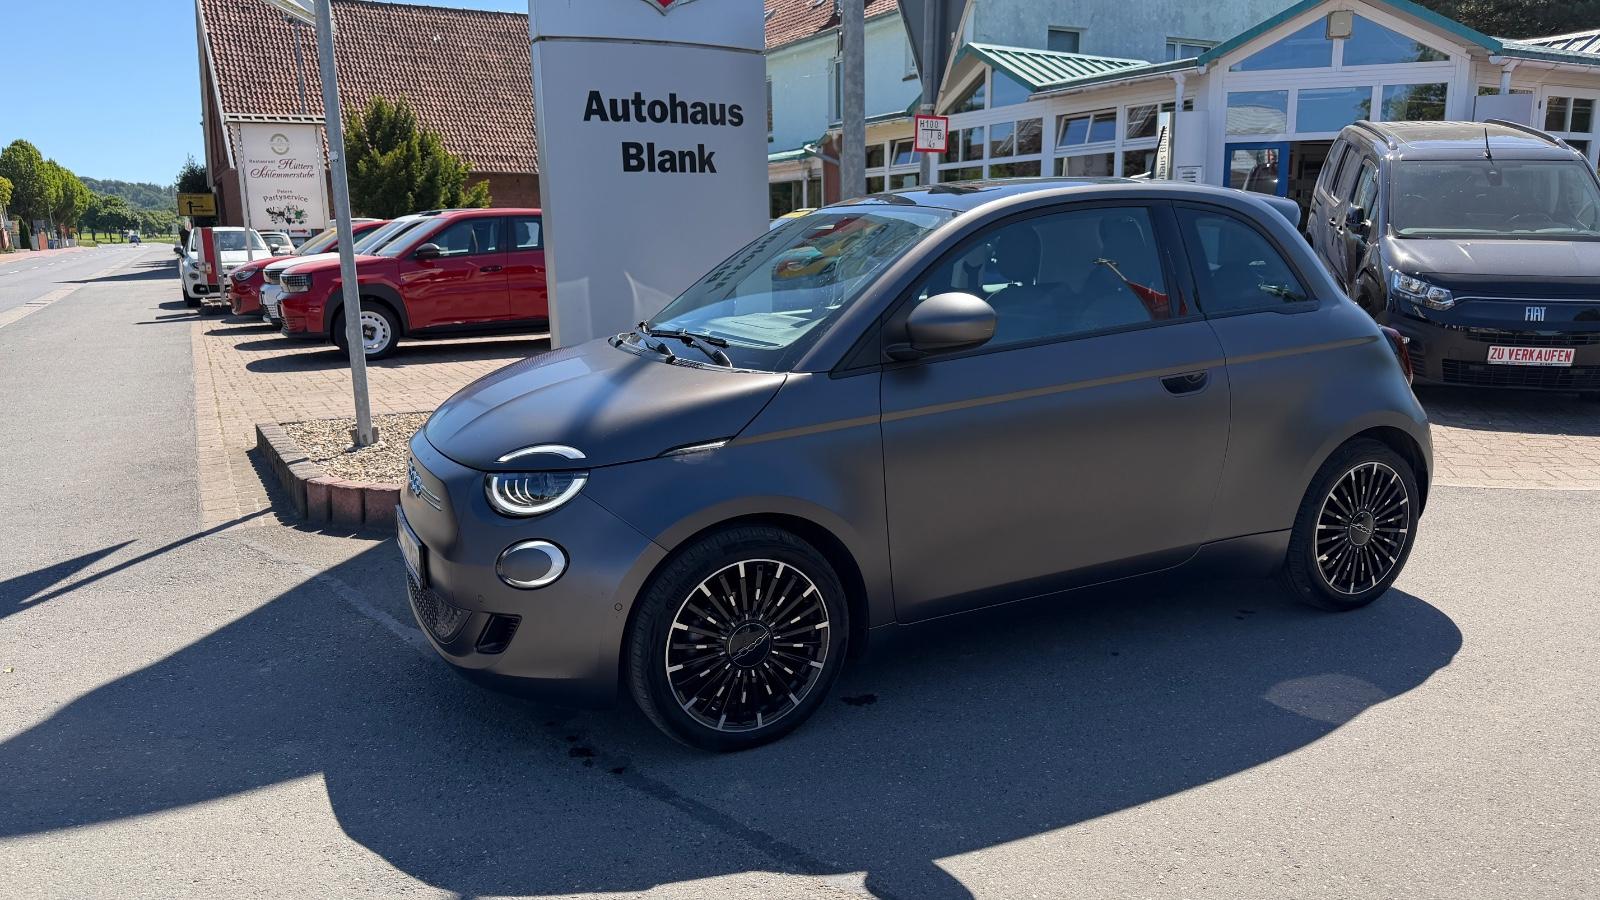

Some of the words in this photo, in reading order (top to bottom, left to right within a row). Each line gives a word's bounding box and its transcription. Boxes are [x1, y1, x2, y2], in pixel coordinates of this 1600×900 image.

[583, 90, 744, 127] Autohaus
[920, 120, 938, 128] H100
[621, 141, 717, 174] Blank
[250, 165, 315, 178] Schlemmerstube
[263, 193, 309, 203] Partyservice
[1524, 306, 1547, 322] FIAT
[1490, 347, 1505, 360] ZU
[1508, 349, 1572, 362] VERKAUFEN
